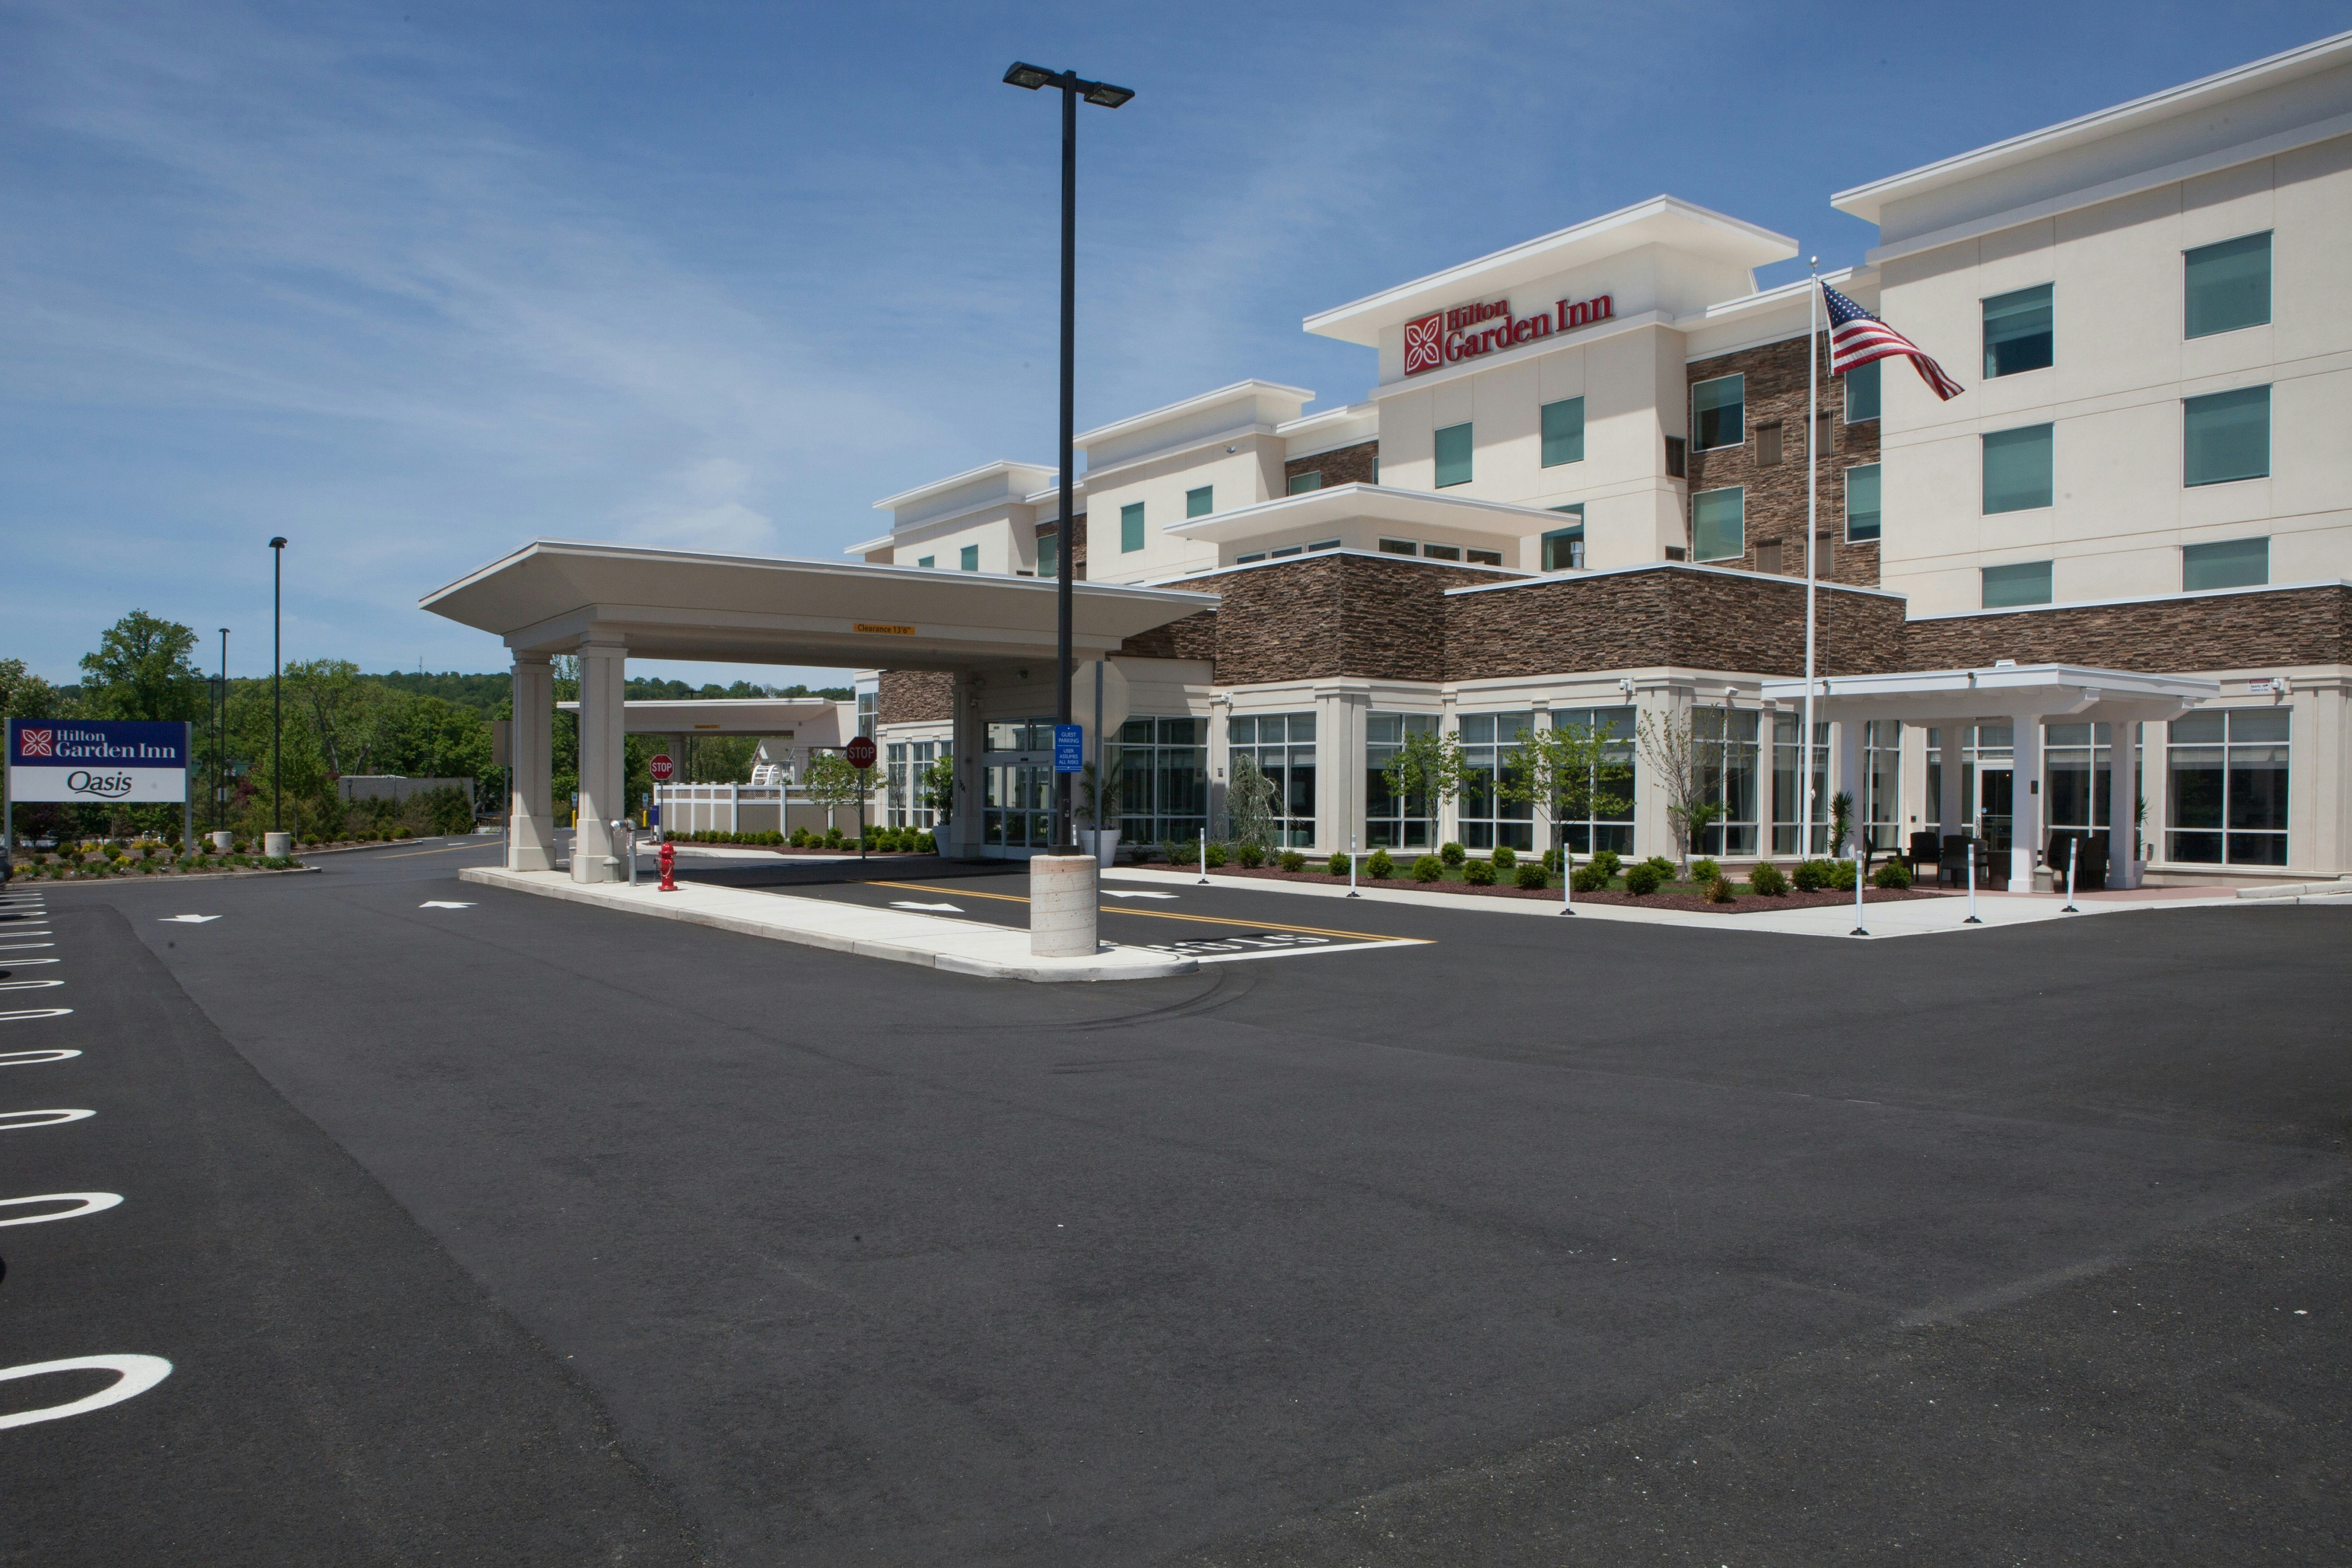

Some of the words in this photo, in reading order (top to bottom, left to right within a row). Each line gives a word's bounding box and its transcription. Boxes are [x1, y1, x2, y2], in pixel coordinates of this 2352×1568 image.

[1445, 299, 1509, 331] Hilton
[1444, 314, 1551, 362] Garden
[1555, 295, 1614, 332] Inn
[858, 624, 891, 632] Clearance
[57, 730, 105, 741] Hilton
[55, 742, 135, 757] Garden
[139, 743, 176, 758] Inn
[848, 747, 875, 758] STOP
[652, 763, 672, 772] STOP
[67, 771, 132, 791] Oasis
